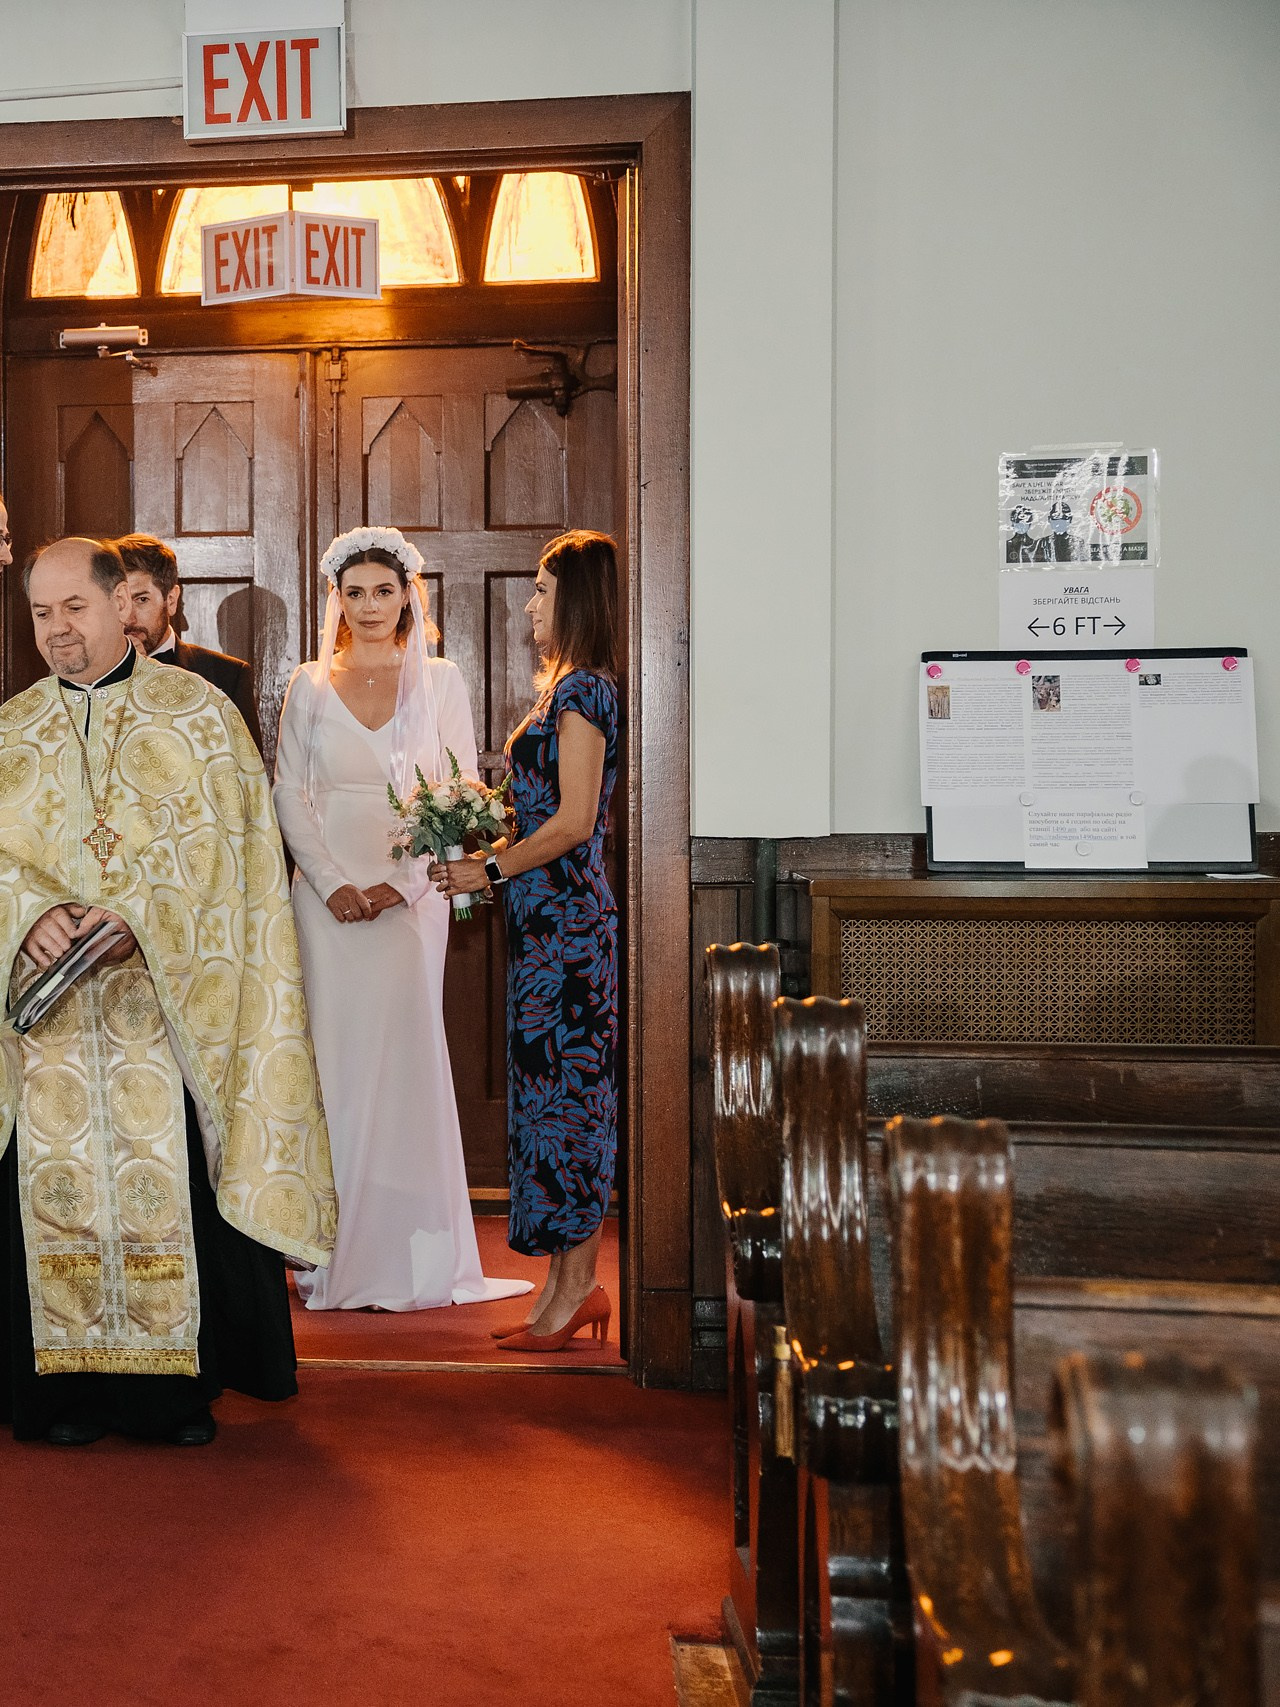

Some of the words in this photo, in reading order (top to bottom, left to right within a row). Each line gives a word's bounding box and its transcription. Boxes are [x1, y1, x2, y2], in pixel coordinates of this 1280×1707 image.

[202, 38, 319, 125] EXIT
[214, 224, 278, 294] EXIT
[305, 223, 366, 288] EXIT
[1032, 597, 1078, 605] ЗБЕРІГАЙТЕ
[1080, 597, 1121, 605] ВІДСТАНЬ
[1063, 586, 1089, 594] УВАГА
[1053, 617, 1066, 636] 6
[1075, 617, 1101, 635] FT
